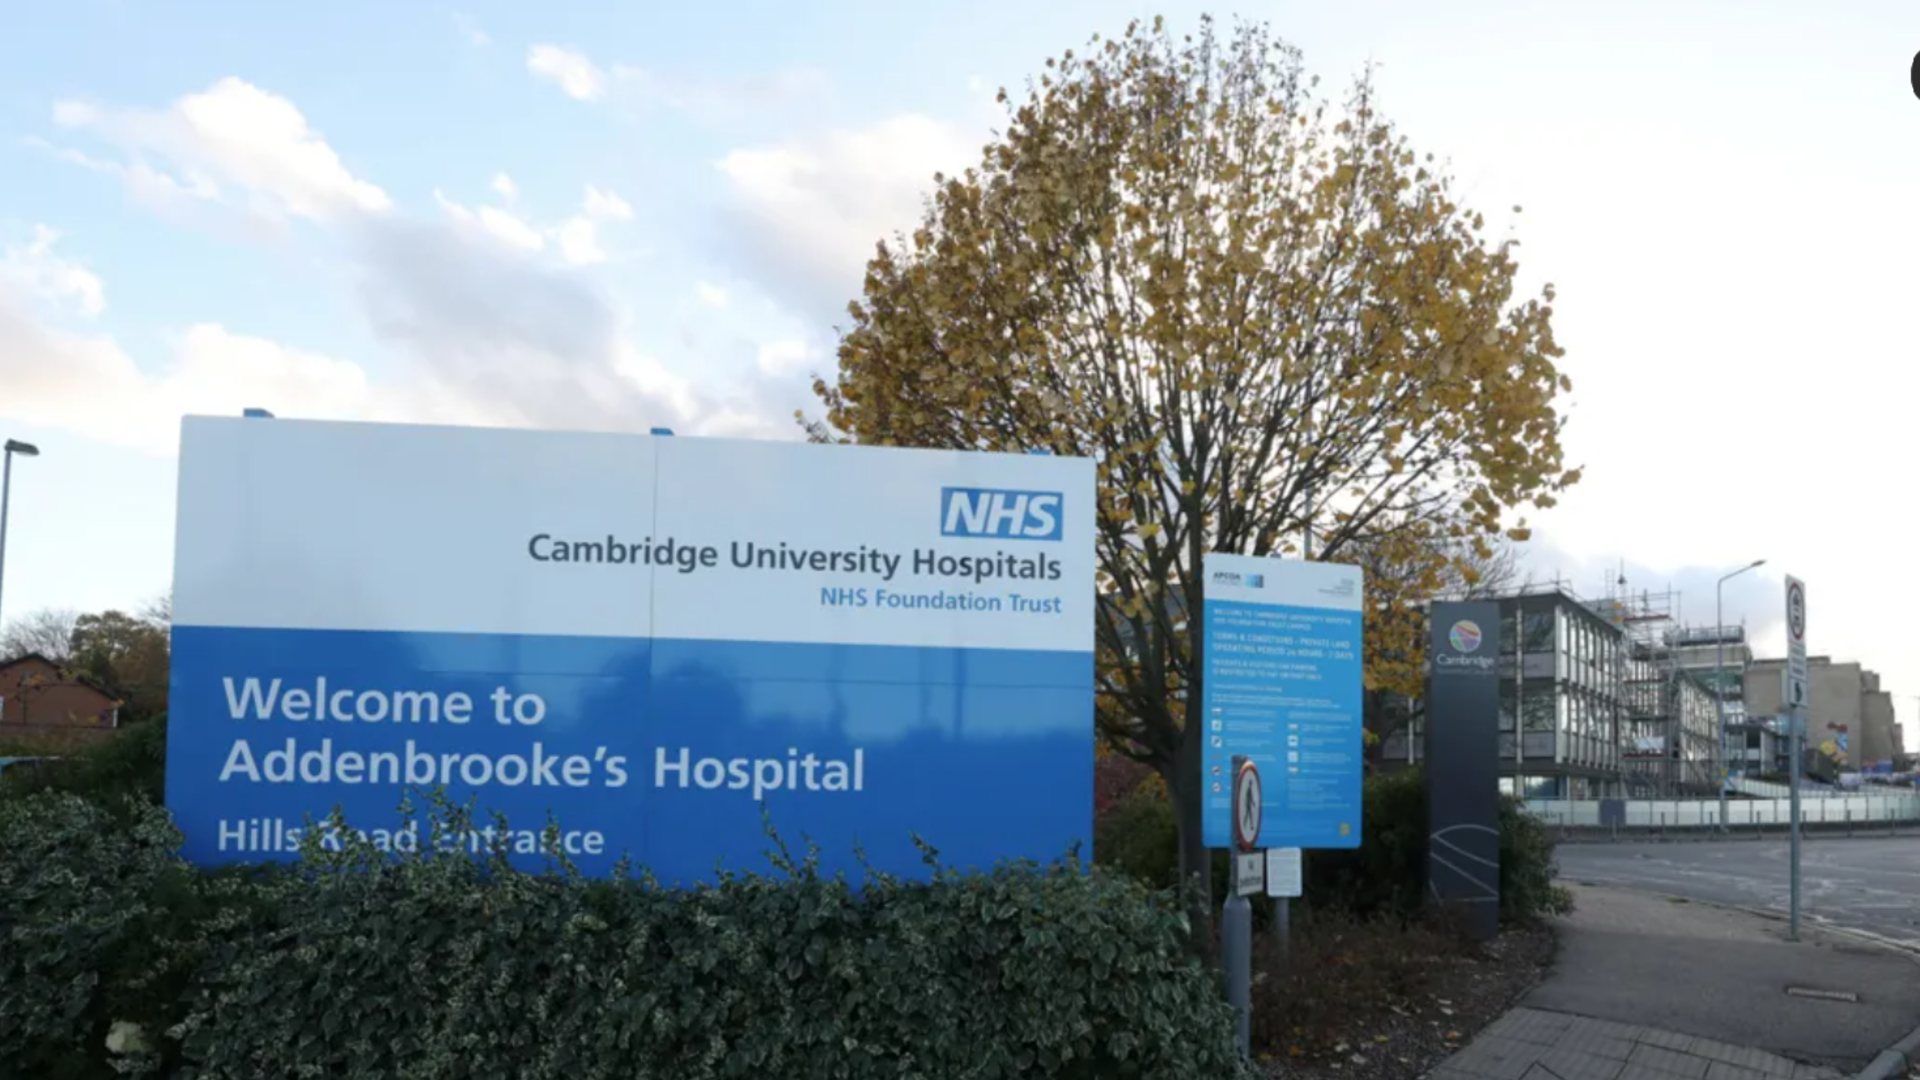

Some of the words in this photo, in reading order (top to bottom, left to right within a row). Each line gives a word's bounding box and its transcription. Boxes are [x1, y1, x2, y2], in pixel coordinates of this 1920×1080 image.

[943, 491, 1058, 537] NHS
[528, 533, 718, 574] Cambridge
[731, 541, 901, 581] University
[913, 548, 1061, 584] Hospitals
[820, 587, 868, 606] NHS
[876, 589, 1001, 611] Foundation
[1009, 594, 1061, 613] Trust
[1436, 653, 1494, 669] Cambridge
[222, 676, 473, 724] Welcome
[490, 686, 546, 725] to
[218, 738, 628, 787] Addenbrooke's
[654, 747, 863, 801] Hospital
[219, 818, 301, 851] Hills
